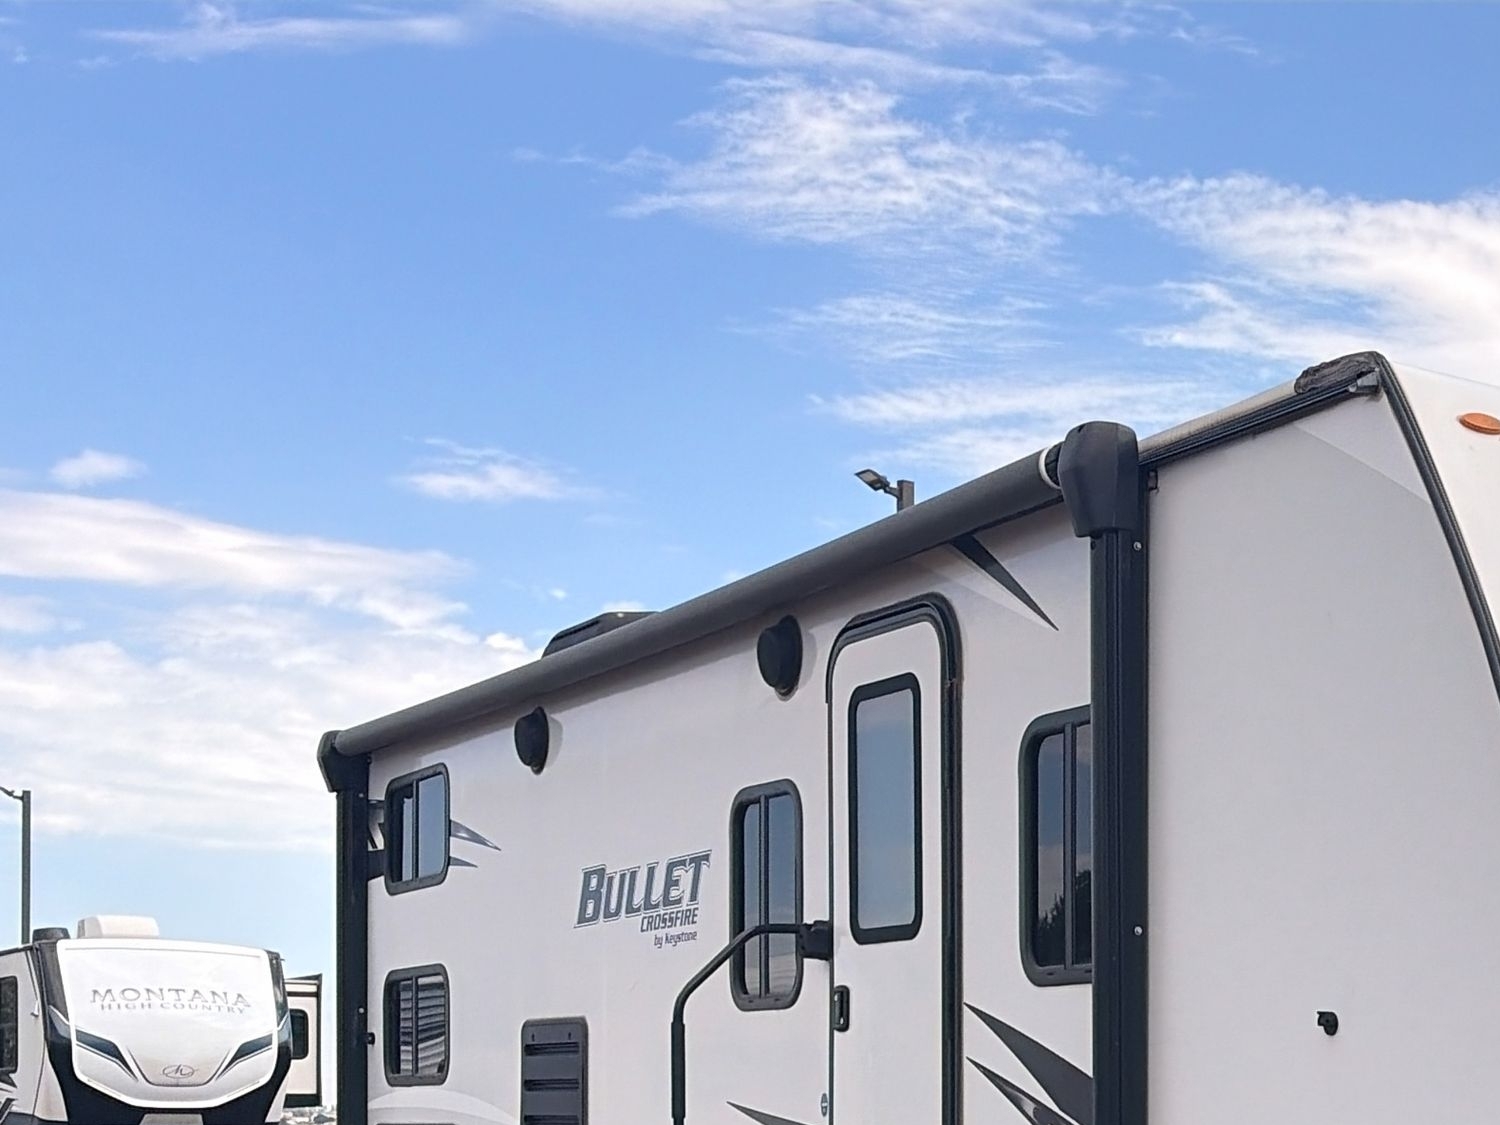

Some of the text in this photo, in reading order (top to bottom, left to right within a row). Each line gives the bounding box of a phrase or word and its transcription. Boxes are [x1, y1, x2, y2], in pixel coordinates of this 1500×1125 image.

[574, 849, 712, 928] BULLET
[640, 908, 699, 932] CROSSFIRE
[654, 934, 663, 949] by
[91, 988, 251, 1007] MONTANA
[101, 1002, 245, 1014] HIGH COUNTRY
